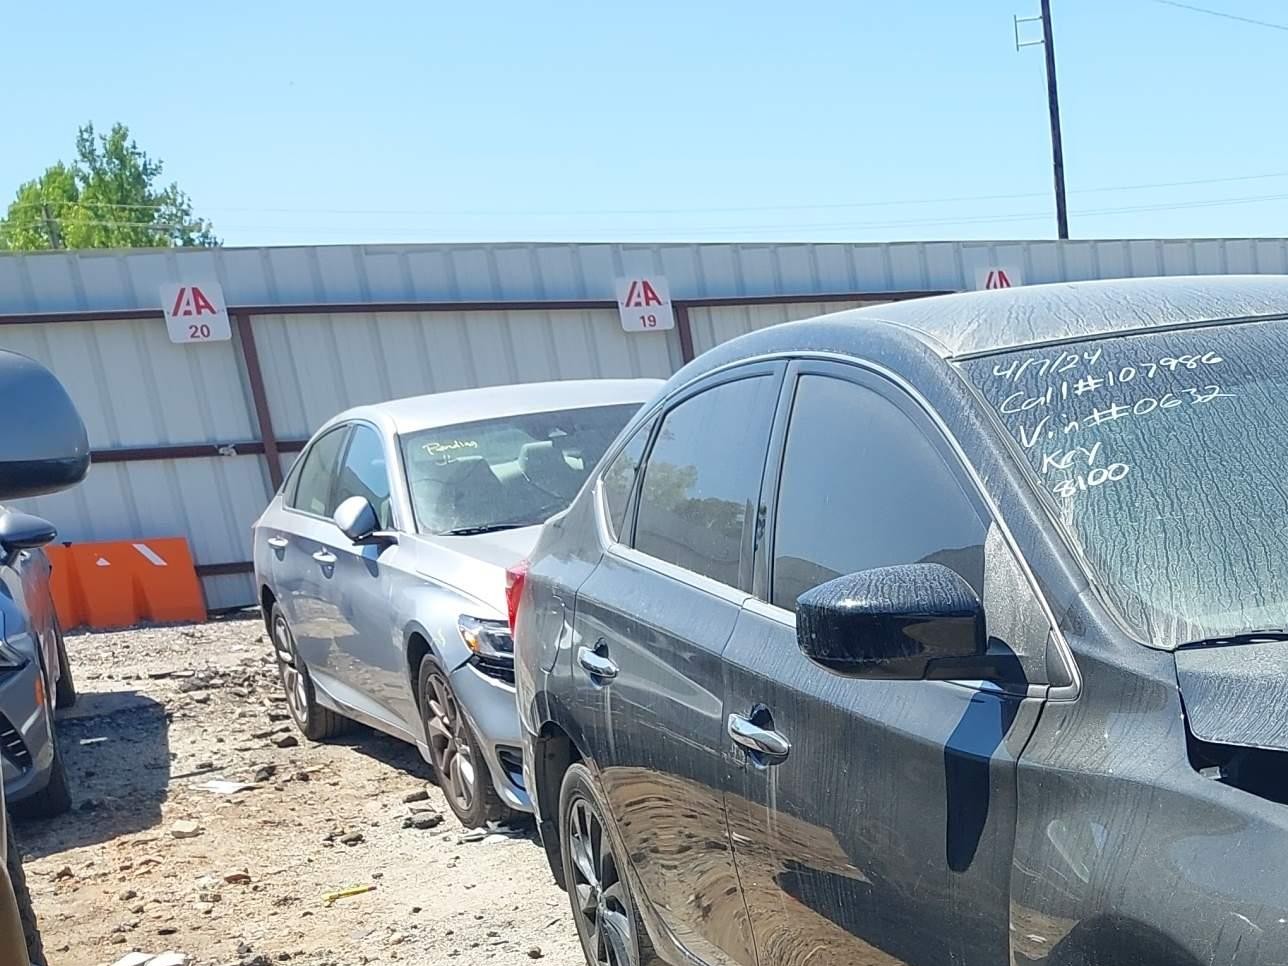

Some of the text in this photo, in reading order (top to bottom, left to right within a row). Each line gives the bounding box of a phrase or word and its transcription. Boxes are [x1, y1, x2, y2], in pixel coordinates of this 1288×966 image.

[188, 324, 211, 339] 20
[640, 314, 657, 328] 19
[992, 348, 1102, 382] 4/7/24
[1053, 462, 1130, 498] 8100
